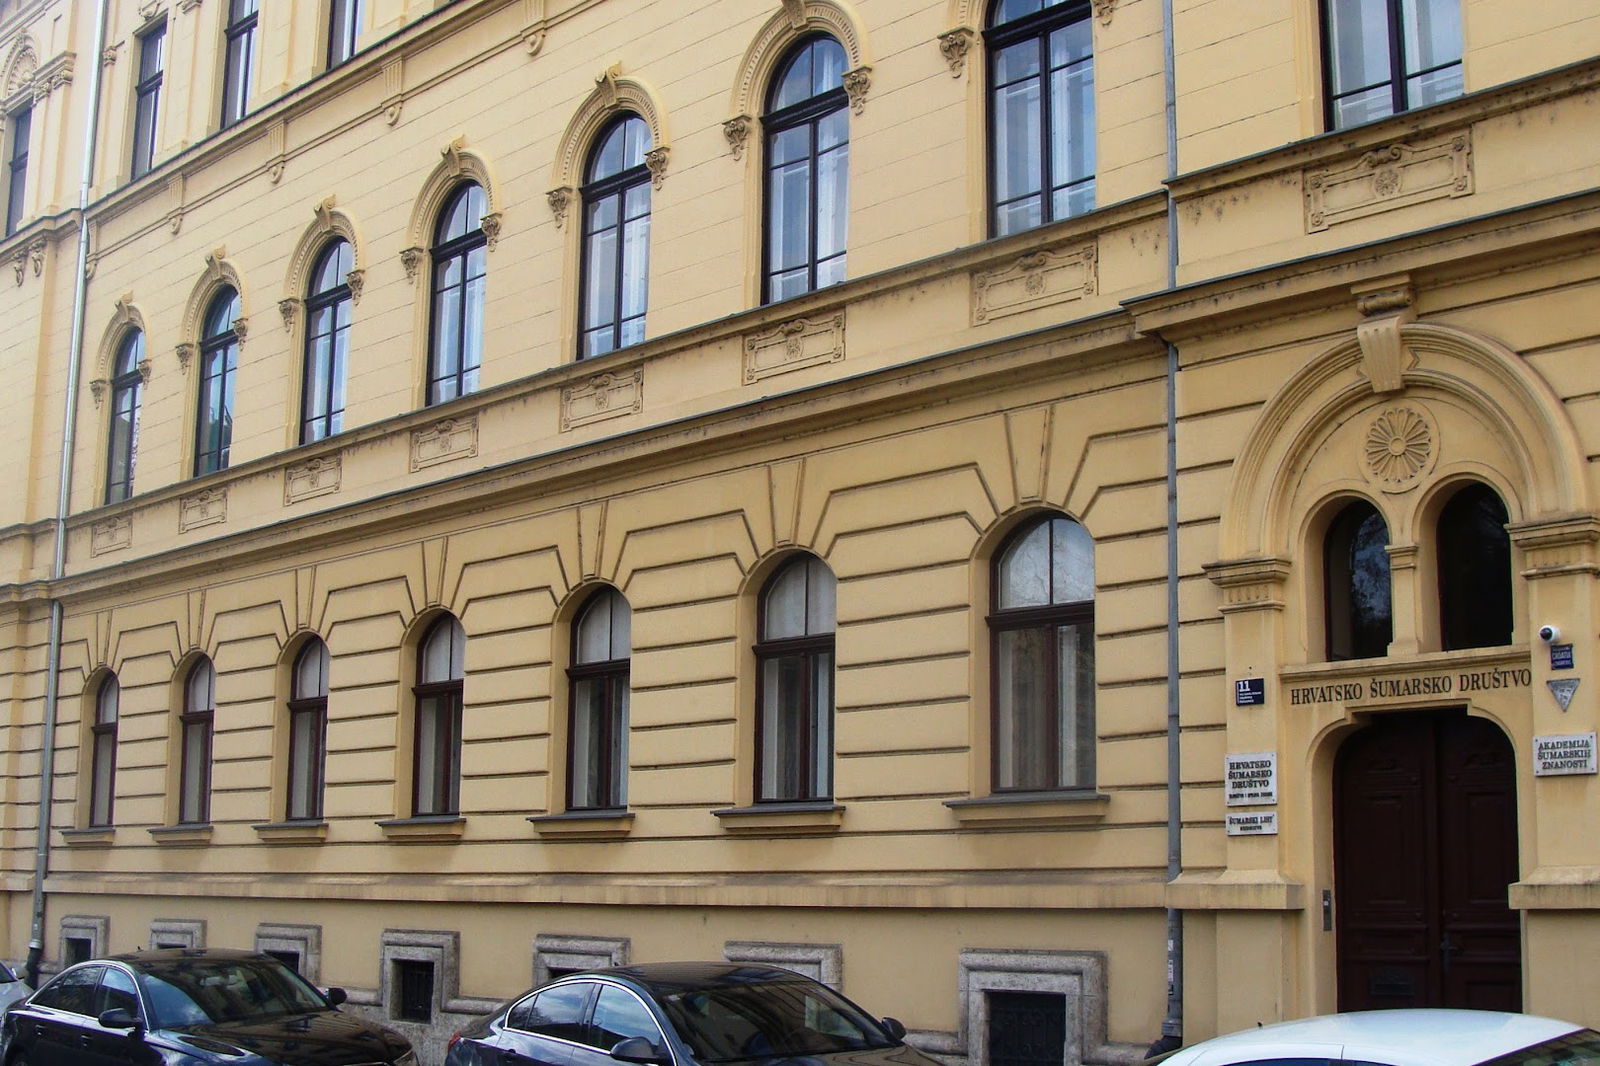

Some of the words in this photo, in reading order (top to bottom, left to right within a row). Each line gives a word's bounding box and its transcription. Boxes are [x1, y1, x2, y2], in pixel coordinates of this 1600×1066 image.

[1239, 680, 1250, 692] 11
[1291, 683, 1363, 705] HRVATSKO
[1370, 675, 1452, 698] ŠUMARSKO
[1459, 667, 1532, 691] DRUŠTVO
[1538, 739, 1591, 750] AKADEMIJA
[1229, 760, 1271, 770] HRVATSKO
[1542, 760, 1587, 770] ZNANOSTI
[1228, 769, 1272, 780] ŠUMARSKO
[1232, 779, 1269, 789] DRUŠTVO
